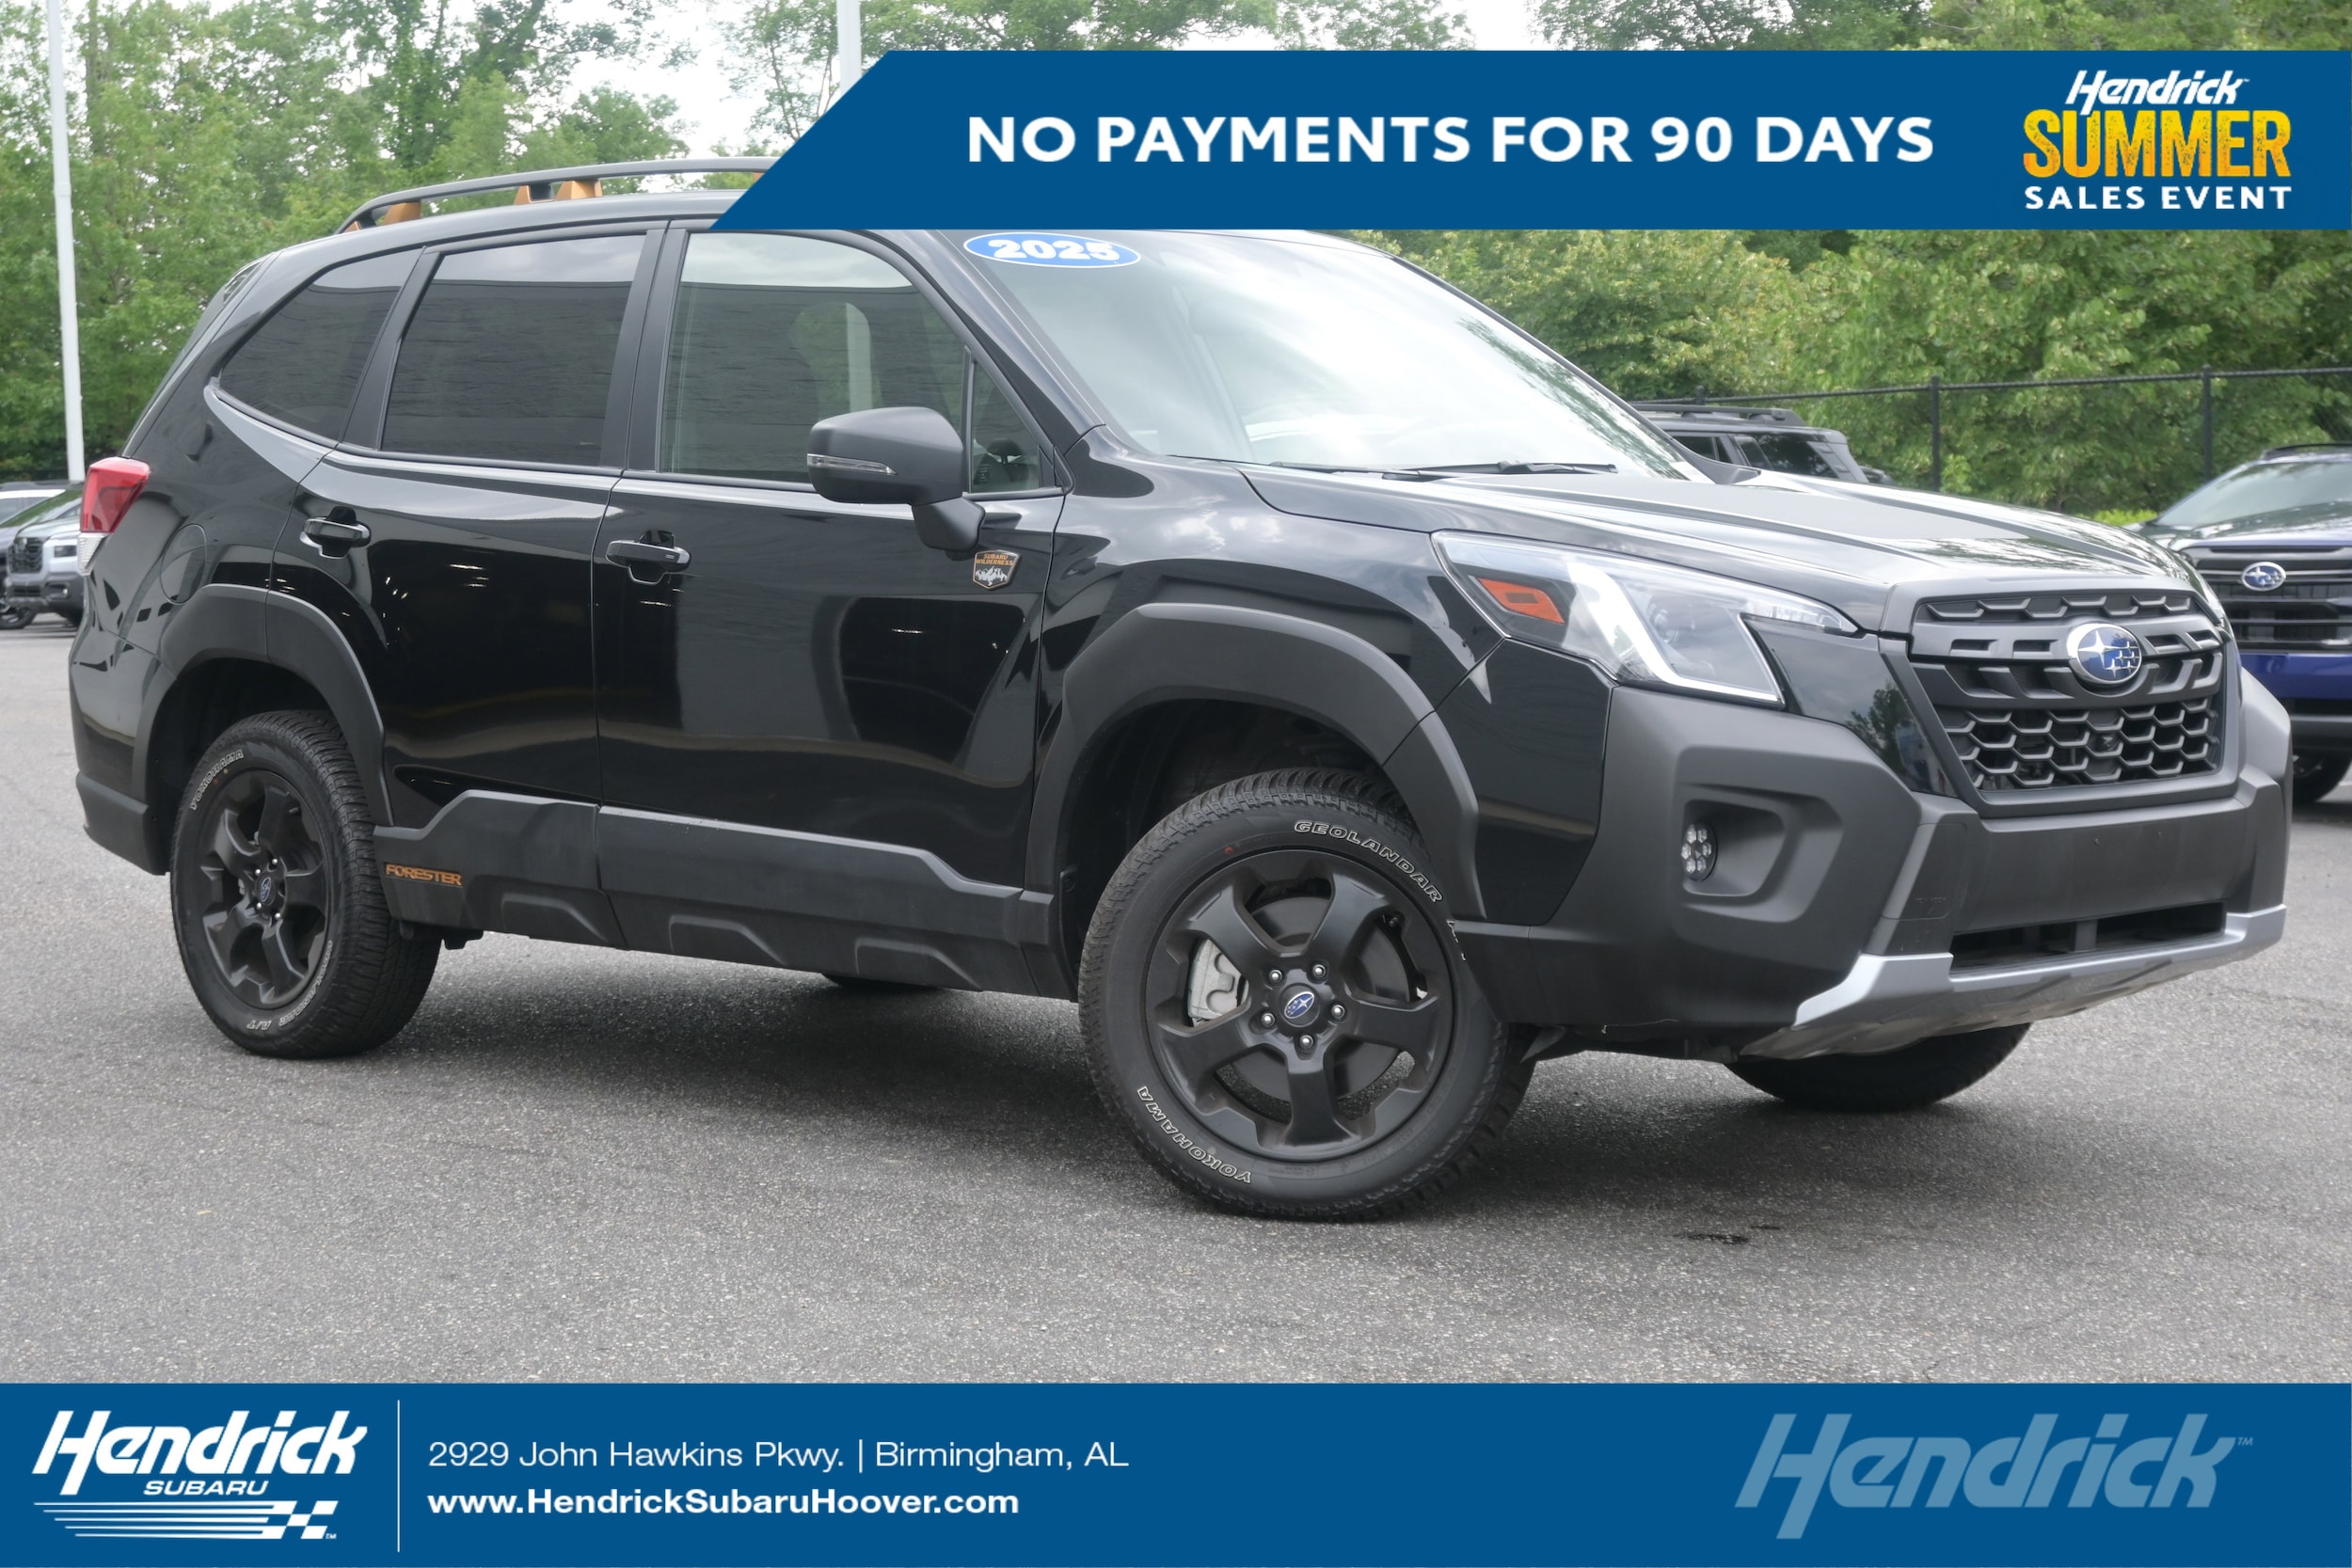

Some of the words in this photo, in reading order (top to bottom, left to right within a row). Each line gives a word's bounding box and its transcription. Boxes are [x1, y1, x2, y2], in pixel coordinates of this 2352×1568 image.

[988, 239, 1120, 261] 2025
[386, 863, 462, 886] FORESTER
[1295, 819, 1443, 903] GEOLANDAR
[1137, 1086, 1251, 1184] YOKOHAMA
